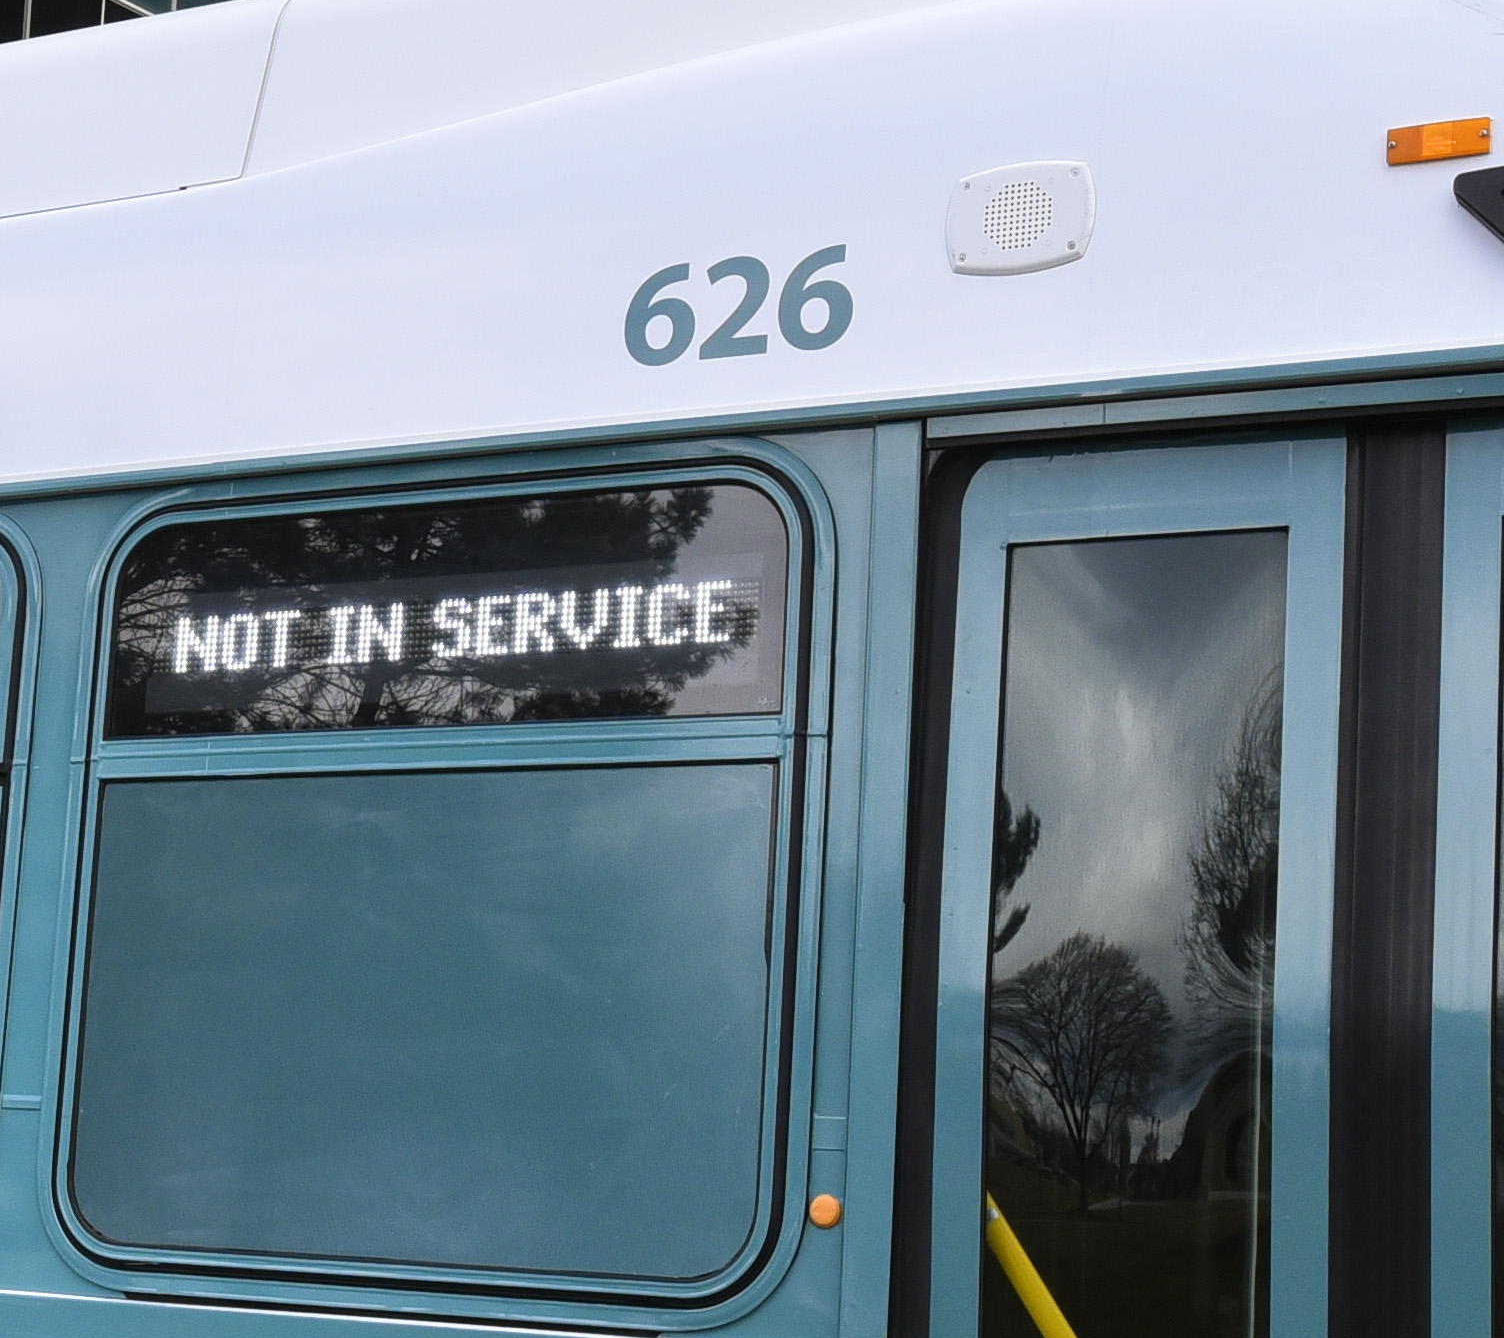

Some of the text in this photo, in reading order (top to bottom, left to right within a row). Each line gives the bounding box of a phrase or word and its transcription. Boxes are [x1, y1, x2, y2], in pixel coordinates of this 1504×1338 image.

[624, 243, 854, 367] 626
[175, 579, 732, 673] NOT IN SERVICE
